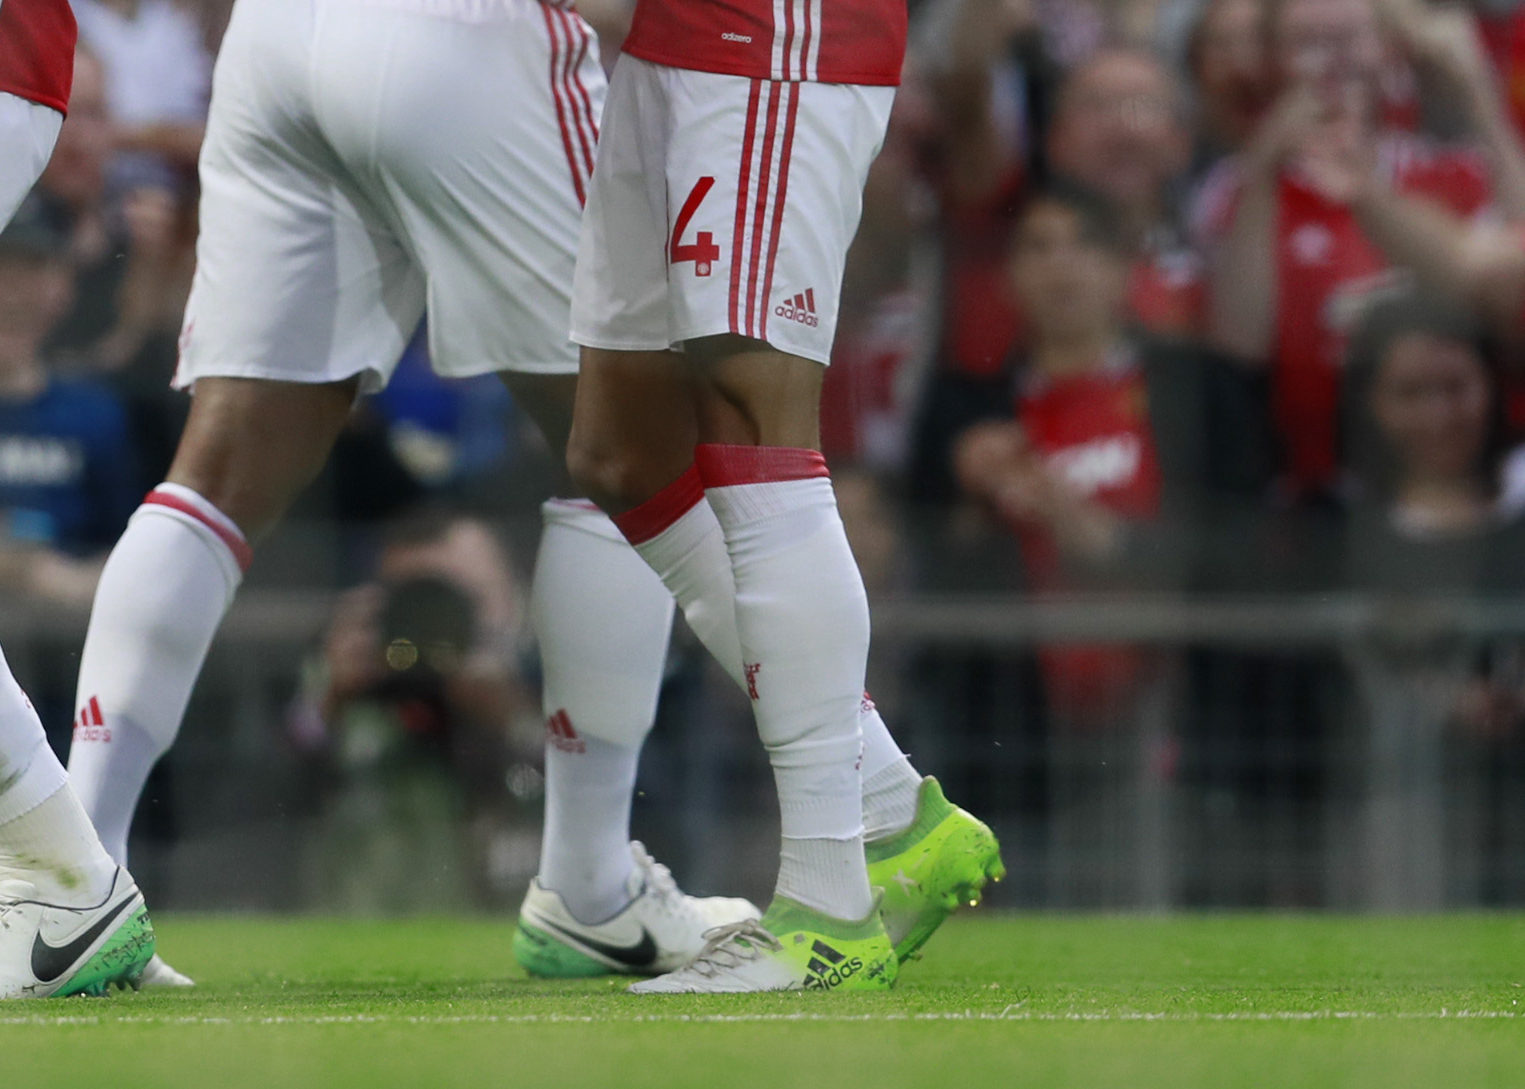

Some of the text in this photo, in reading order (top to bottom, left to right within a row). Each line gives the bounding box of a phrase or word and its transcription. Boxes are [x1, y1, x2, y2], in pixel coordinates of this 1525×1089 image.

[721, 31, 752, 43] adizero
[664, 175, 720, 277] 4
[775, 306, 819, 328] adidas
